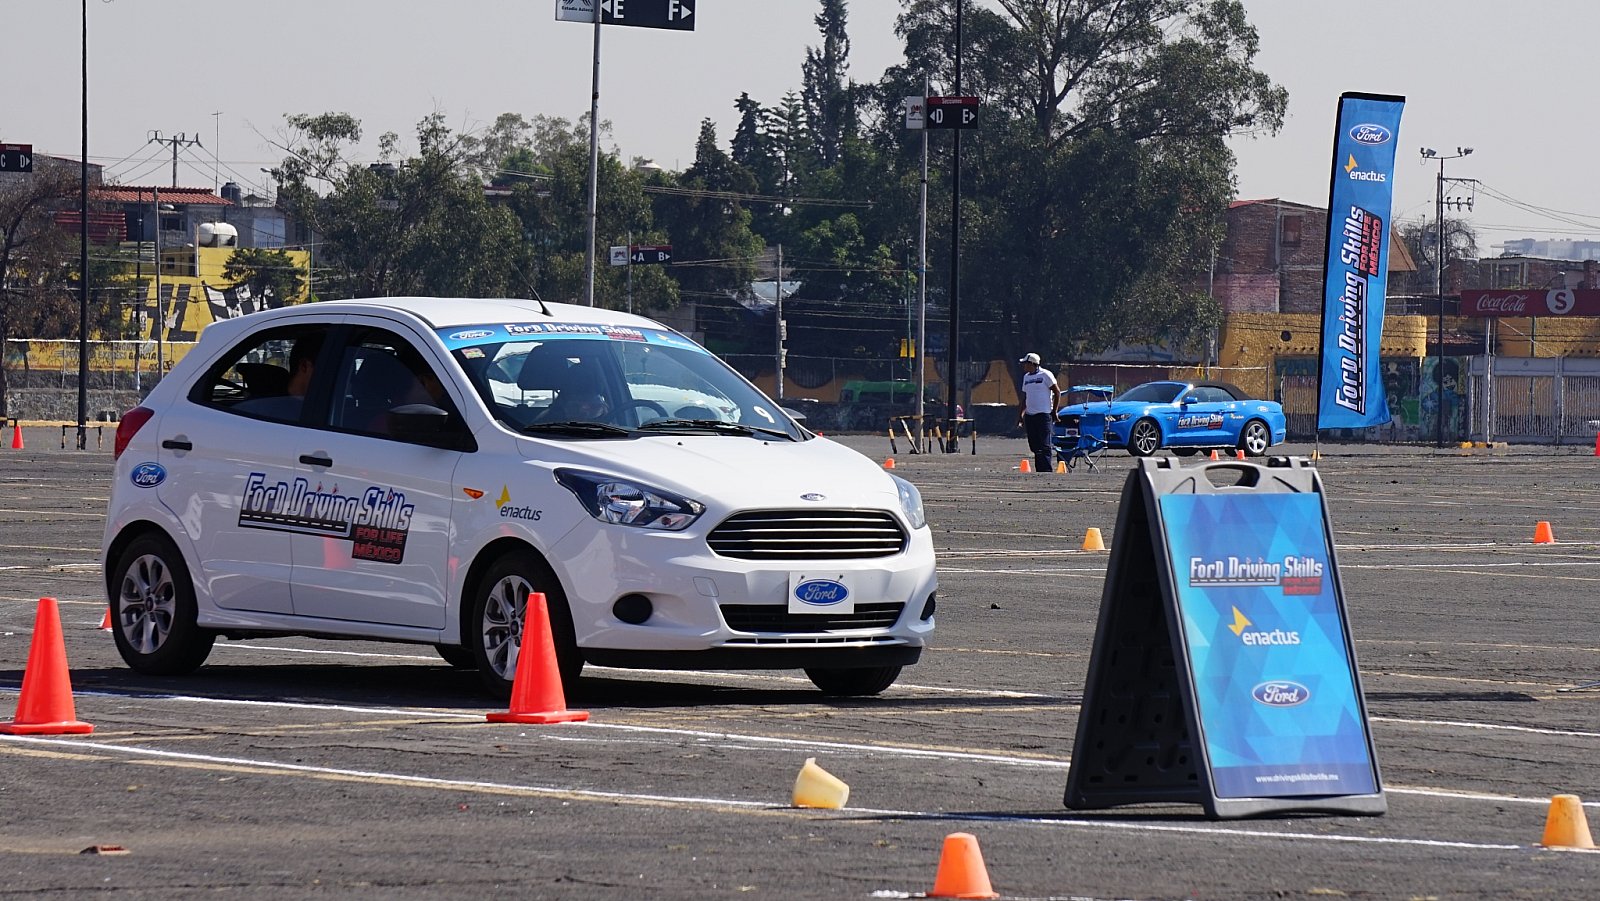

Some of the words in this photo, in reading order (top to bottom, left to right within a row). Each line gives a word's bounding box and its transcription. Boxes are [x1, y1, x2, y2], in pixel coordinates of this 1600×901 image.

[613, 0, 625, 19] E
[668, 0, 680, 21] F
[936, 109, 944, 123] D
[962, 109, 969, 123] E
[1356, 126, 1383, 141] Ford
[0, 153, 6, 168] C
[20, 154, 26, 168] D
[1349, 170, 1386, 182] enactus
[1341, 205, 1364, 269] Skills
[1362, 216, 1372, 244] LIFE
[637, 252, 645, 262] A
[658, 251, 665, 262] B
[1368, 219, 1382, 276] MÉXICO
[1360, 247, 1370, 272] FOR
[1476, 294, 1528, 312] Coca-Cola
[1554, 291, 1567, 310] S
[1339, 270, 1364, 355] Driving
[543, 323, 602, 335] Driving
[602, 325, 643, 336] Skills
[136, 465, 161, 483] Ford
[288, 479, 360, 528] Driving
[358, 487, 415, 531] Skills
[500, 505, 543, 521] enactus
[356, 527, 380, 541] FOR
[380, 530, 405, 545] LIFE
[354, 542, 402, 562] MÉXICO
[1228, 556, 1281, 581] Driving
[1284, 556, 1323, 578] Skills
[804, 583, 838, 601] Ford
[1242, 629, 1301, 646] enactus
[1263, 683, 1300, 703] Ford
